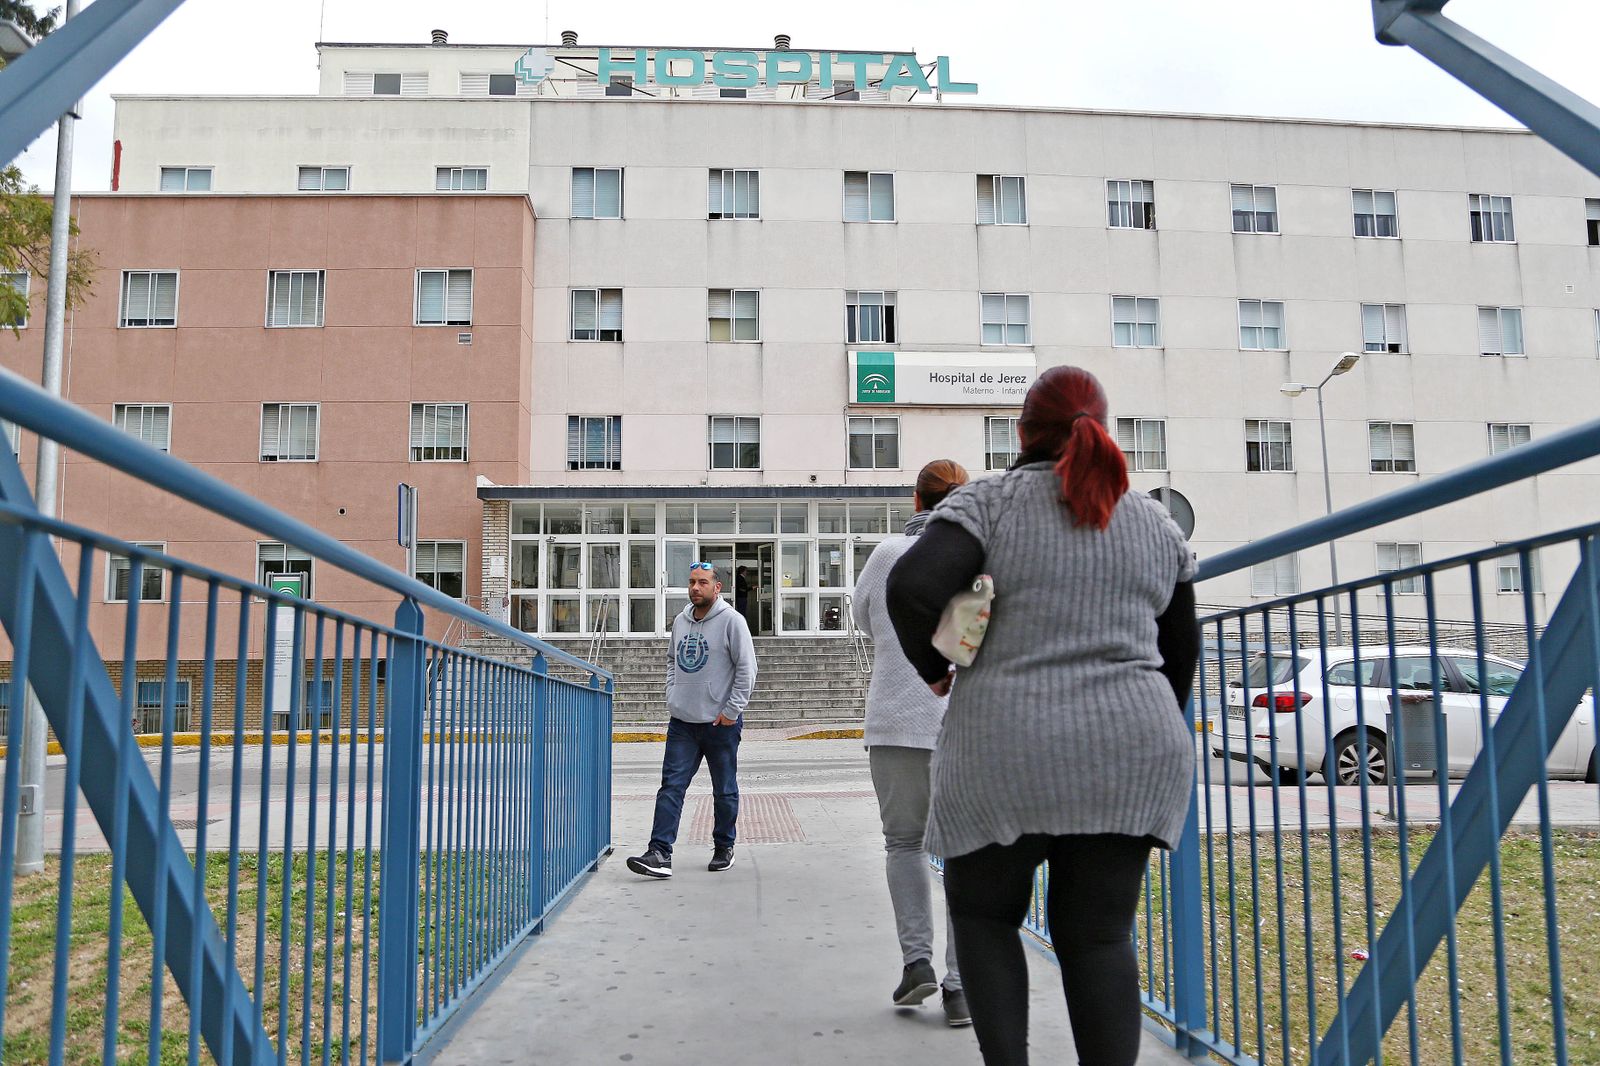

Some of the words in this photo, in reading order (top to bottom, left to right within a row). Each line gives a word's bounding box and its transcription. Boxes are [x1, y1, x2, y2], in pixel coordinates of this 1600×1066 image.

[598, 47, 978, 95] HOSPITAL
[929, 372, 975, 385] Hospital
[979, 372, 994, 383] de
[997, 373, 1027, 384] Jerez
[962, 386, 994, 395] Materno
